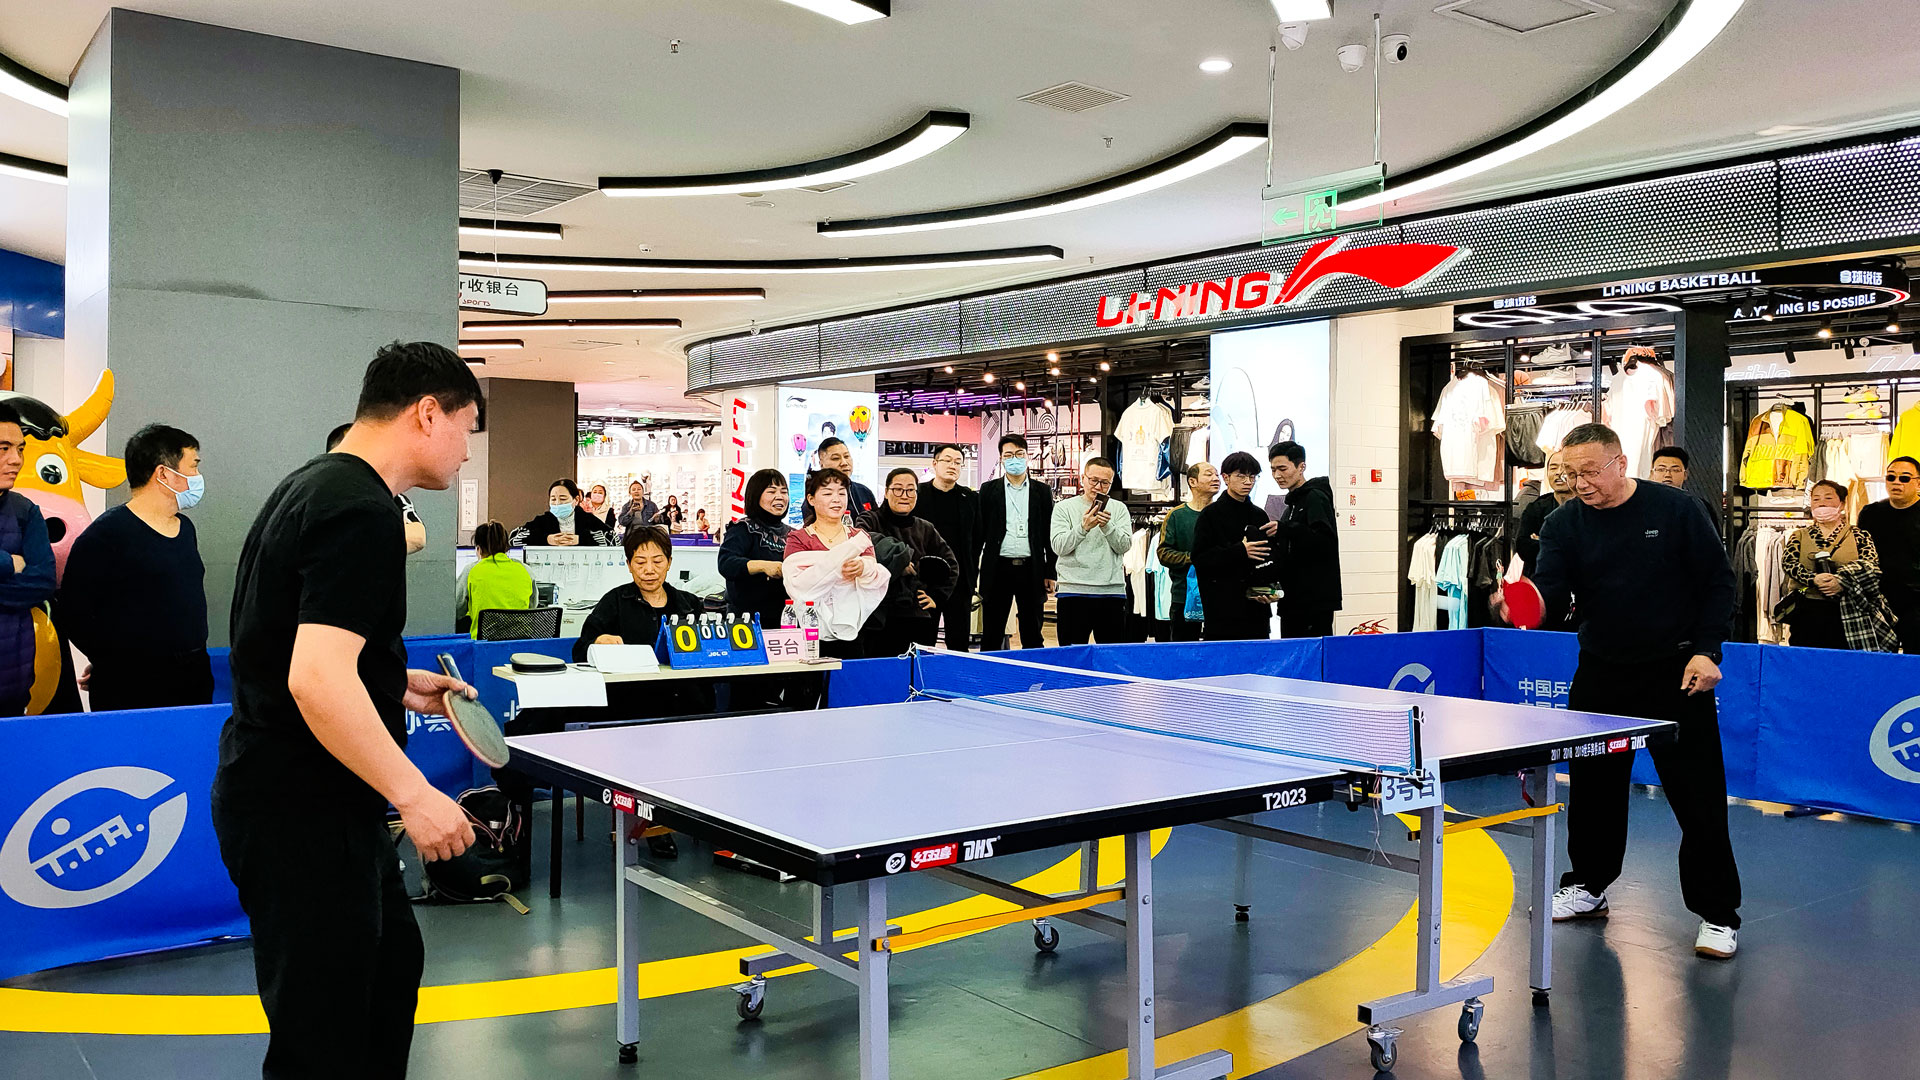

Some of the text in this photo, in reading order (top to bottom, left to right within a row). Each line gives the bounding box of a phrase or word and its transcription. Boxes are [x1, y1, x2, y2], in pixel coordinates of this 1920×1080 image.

[1602, 272, 1762, 297] LI-NING BASKETBALL
[1096, 271, 1272, 328] LI-NING
[1807, 301, 1820, 312] IS
[1823, 292, 1877, 310] POSSIBLE
[675, 623, 753, 653] 0 0 0 0
[1518, 677, 1573, 698] 中国乒
[1262, 787, 1308, 811] T2023
[963, 837, 998, 861] DHS
